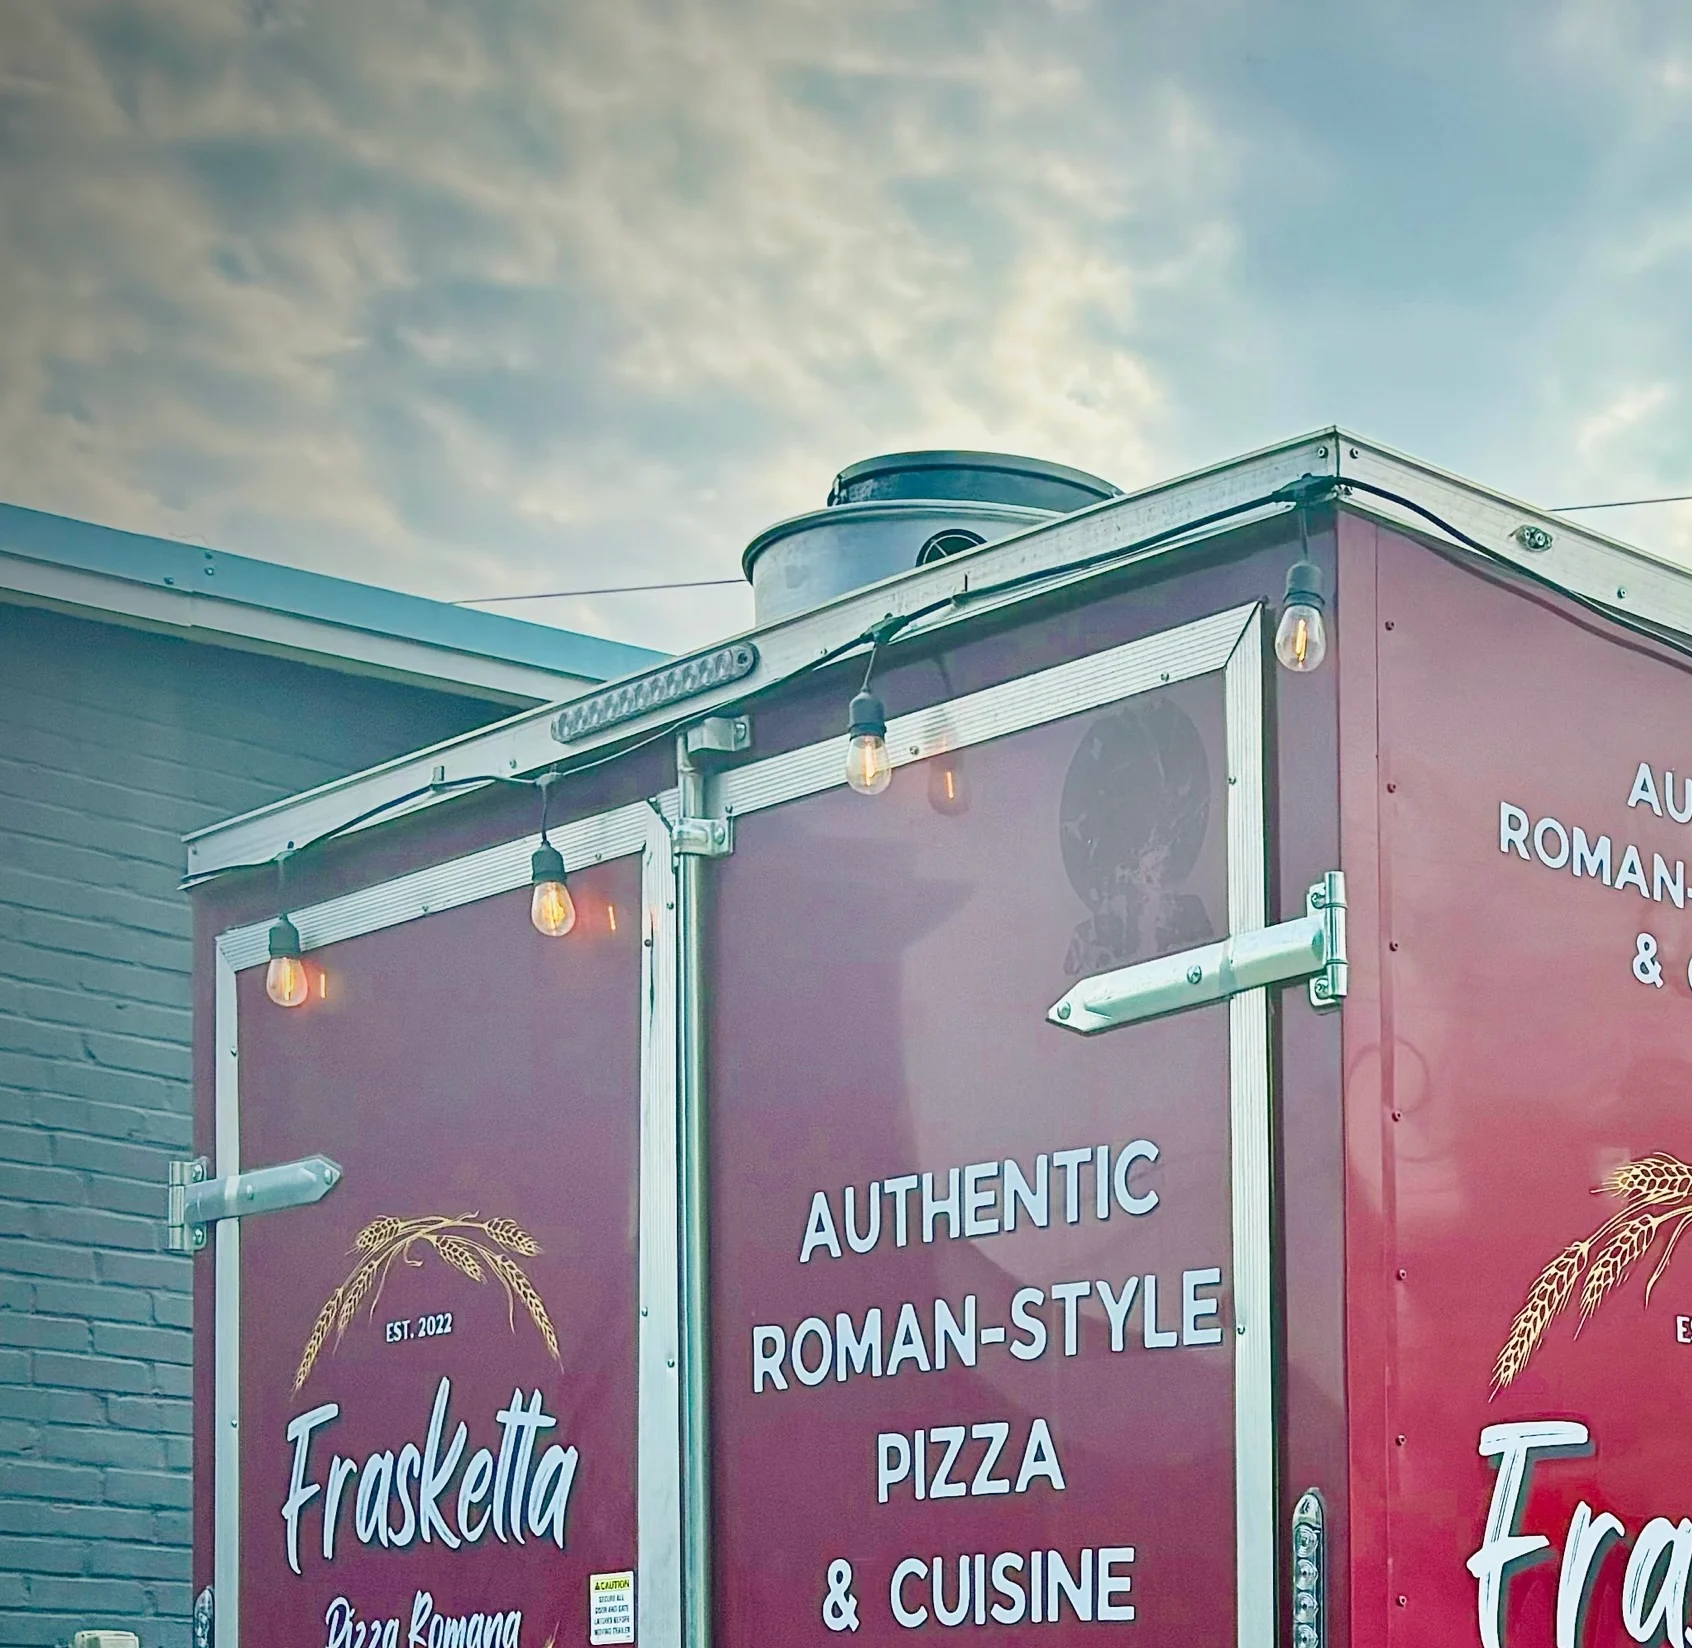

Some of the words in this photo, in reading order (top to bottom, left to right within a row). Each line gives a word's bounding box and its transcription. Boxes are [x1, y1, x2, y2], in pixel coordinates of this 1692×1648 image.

[1632, 933, 1663, 989] &
[799, 1139, 1160, 1264] AUTHENTIC
[386, 1320, 414, 1343] EST.
[418, 1312, 452, 1339] 2022
[753, 1267, 1222, 1394] ROMAN-STYLE
[281, 1376, 579, 1575] Frasketta
[877, 1418, 1066, 1504] PIZZA
[601, 1580, 630, 1591] CAUTION
[822, 1558, 860, 1632] &
[891, 1546, 1137, 1628] CUISINE
